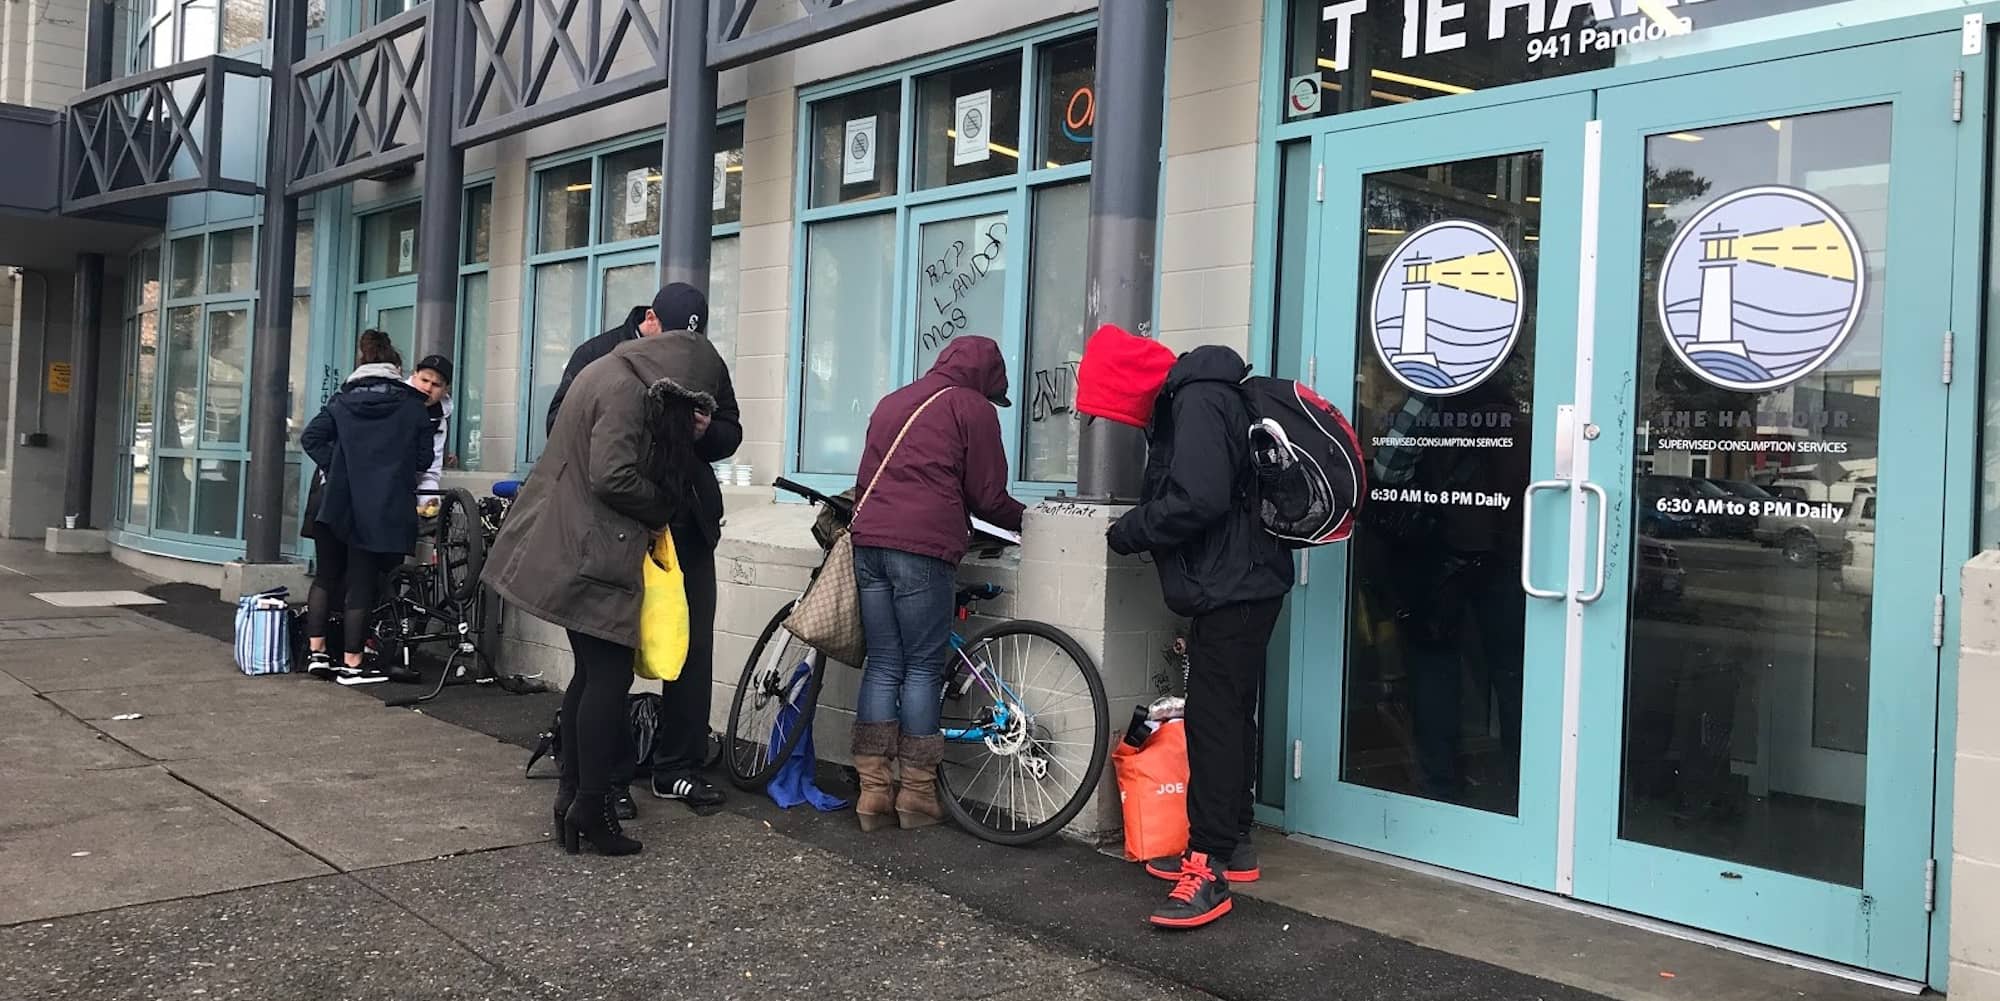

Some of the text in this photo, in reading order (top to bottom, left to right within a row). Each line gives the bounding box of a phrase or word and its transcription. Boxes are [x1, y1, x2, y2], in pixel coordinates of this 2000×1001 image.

[1526, 33, 1571, 63] 941
[925, 240, 964, 287] RIP
[1661, 410, 1706, 428] THE
[1372, 437, 1513, 448] SUPERVISED CONSUMPTION SERVICES
[1658, 438, 1848, 453] SUPERVISED CONSUMPTION SERVICES
[1371, 488, 1511, 510] 6:30 AM to 8 PM Daily
[1656, 497, 1844, 524] 6:30 AM to 8 PM Daily
[1157, 782, 1185, 795] JOE
